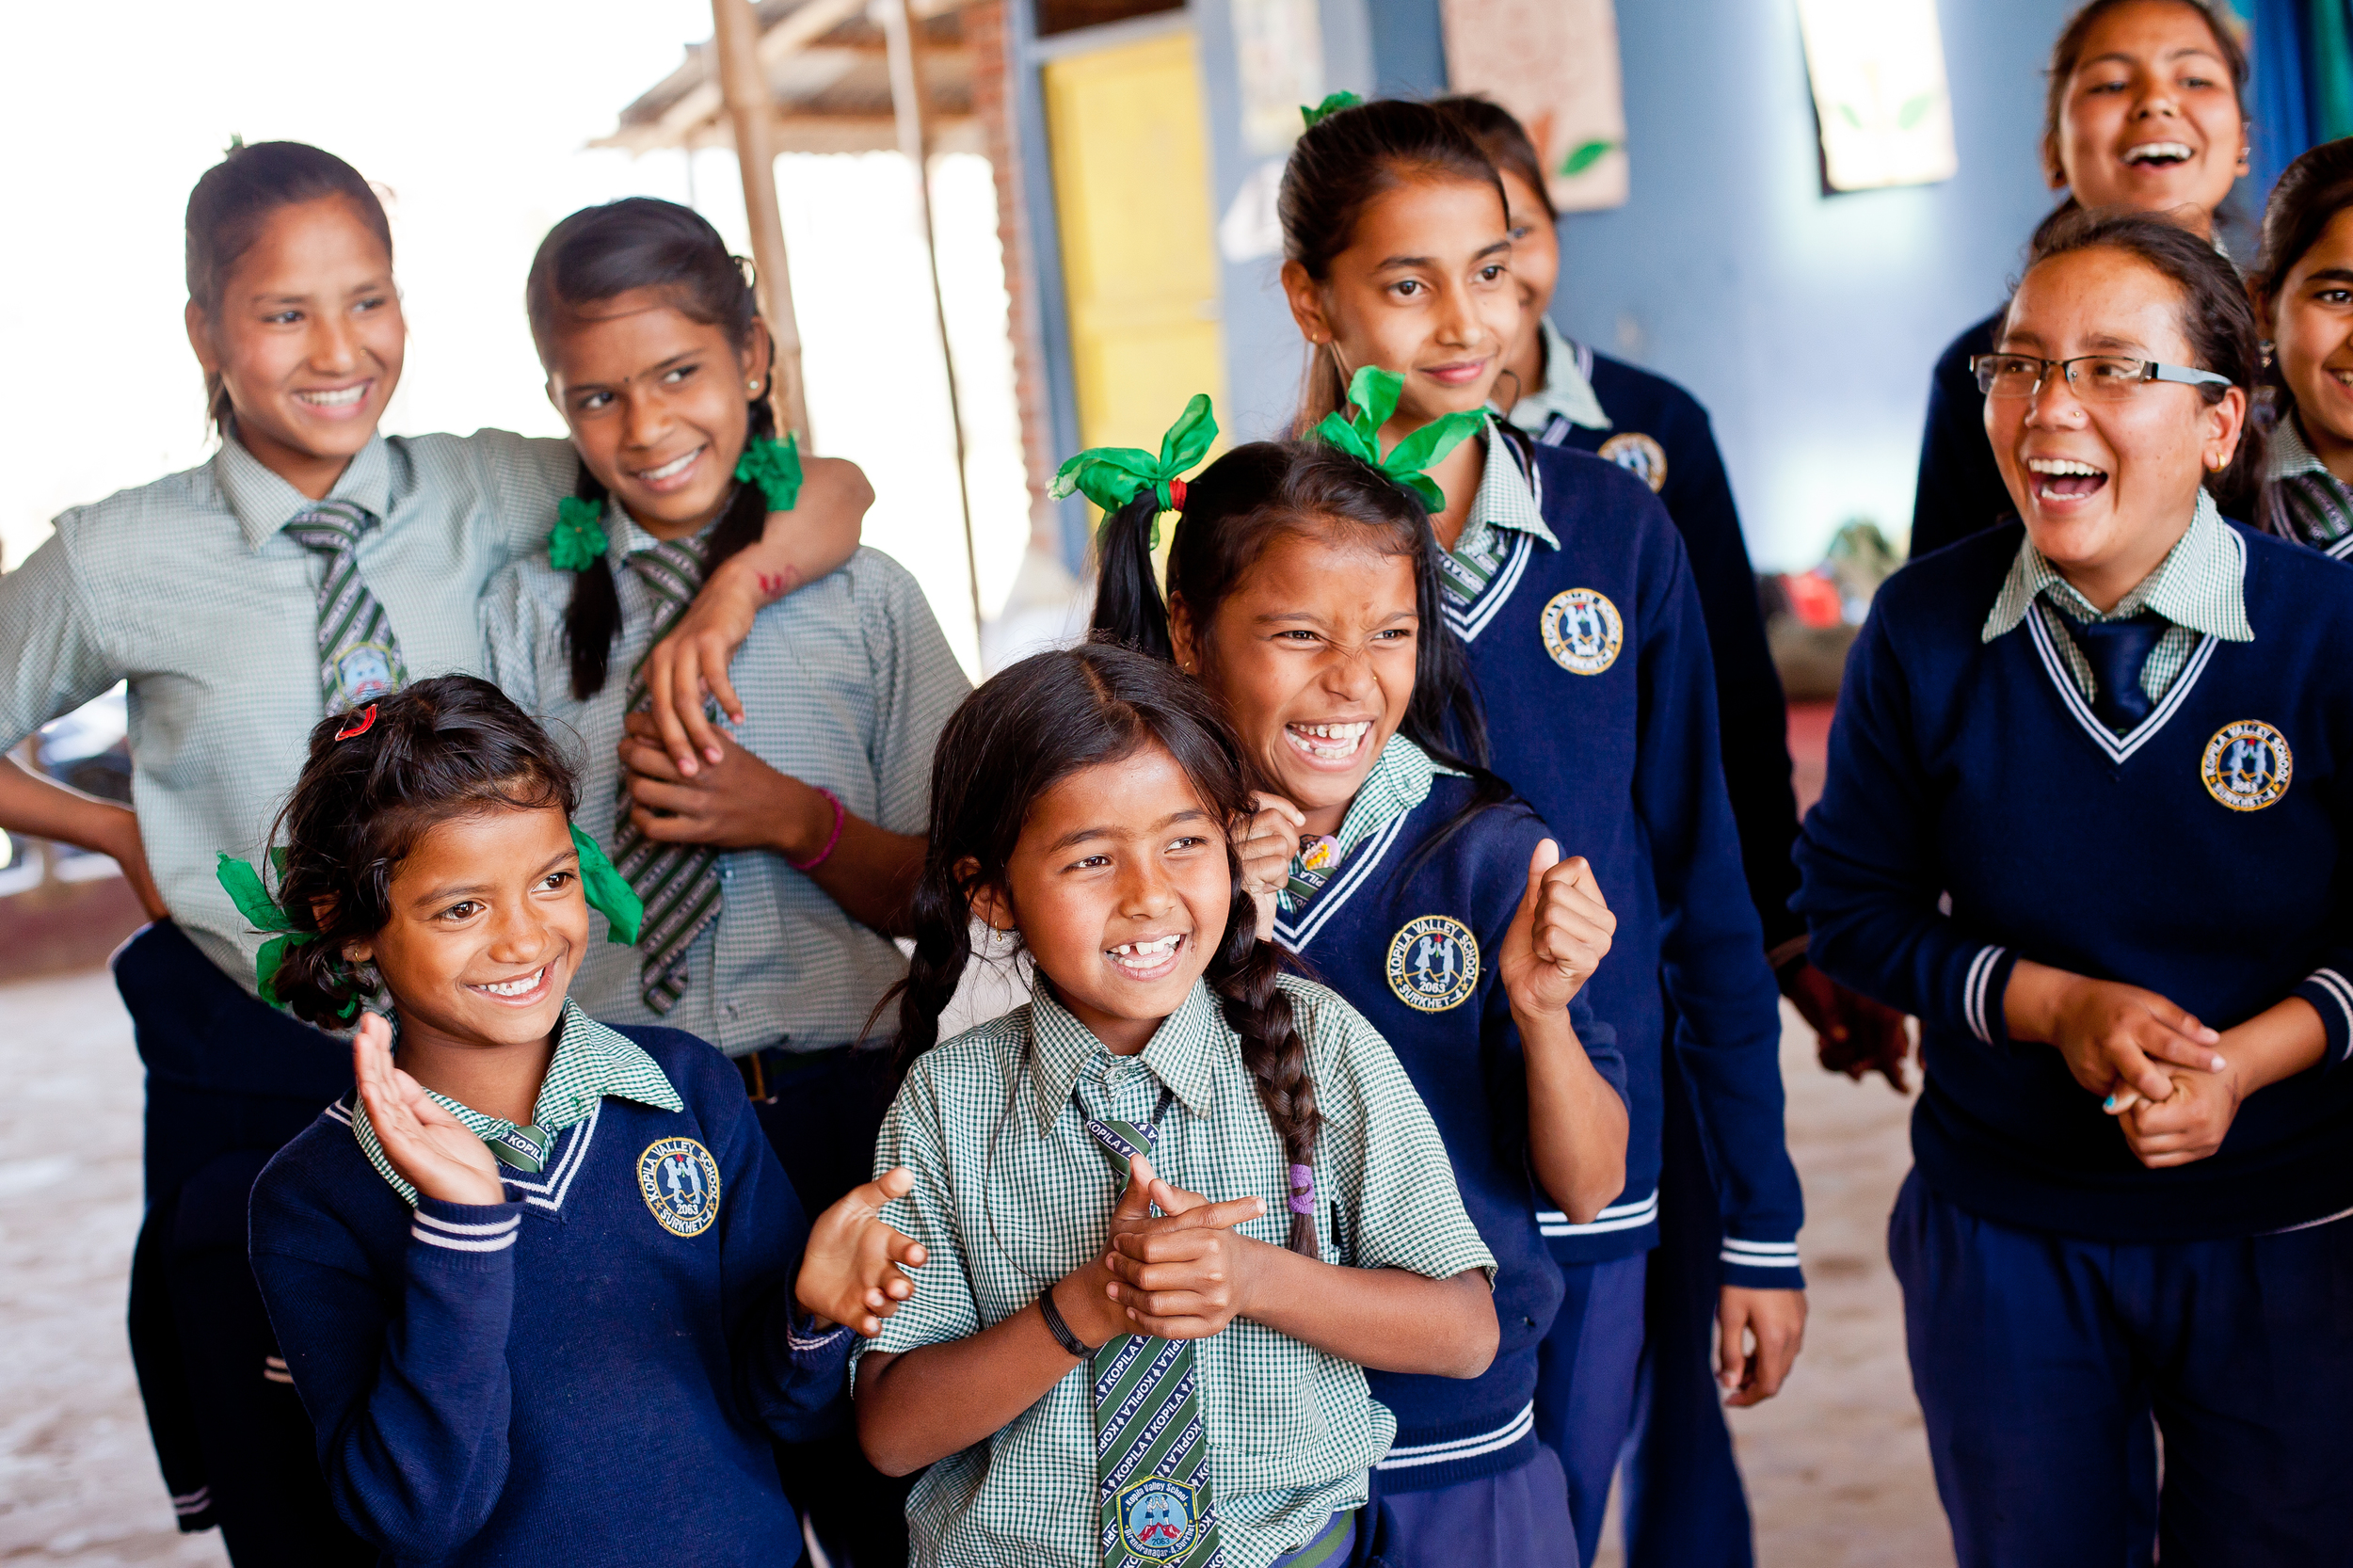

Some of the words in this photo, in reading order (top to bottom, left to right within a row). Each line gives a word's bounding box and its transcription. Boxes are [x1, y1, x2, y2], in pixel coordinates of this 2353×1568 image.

[1300, 871, 1325, 888] PILA
[1390, 932, 1414, 977] KOPILA
[1411, 919, 1460, 936] VALLEY
[1460, 934, 1477, 982] SCHOOL
[1399, 984, 1450, 1009] SURKHET
[1418, 981, 1446, 994] 2063
[508, 1134, 541, 1160] KOPIL
[1086, 1120, 1121, 1149] KOPILA
[650, 1141, 696, 1157] VALLEY
[643, 1157, 659, 1203] KOPILA
[698, 1151, 717, 1200] SCHOOL
[660, 1208, 703, 1233] SURKHET
[676, 1204, 698, 1215] 2063
[1104, 1345, 1139, 1386] KOPILA
[1120, 1374, 1156, 1416] KOPILA
[1150, 1393, 1185, 1433] KOPILA
[1166, 1422, 1202, 1464] KOPILA
[1113, 1441, 1148, 1481] KOPILA
[1125, 1488, 1144, 1507] Kopila
[1143, 1481, 1166, 1493] Valley
[1165, 1482, 1189, 1502] School
[1151, 1538, 1170, 1546] 2063
